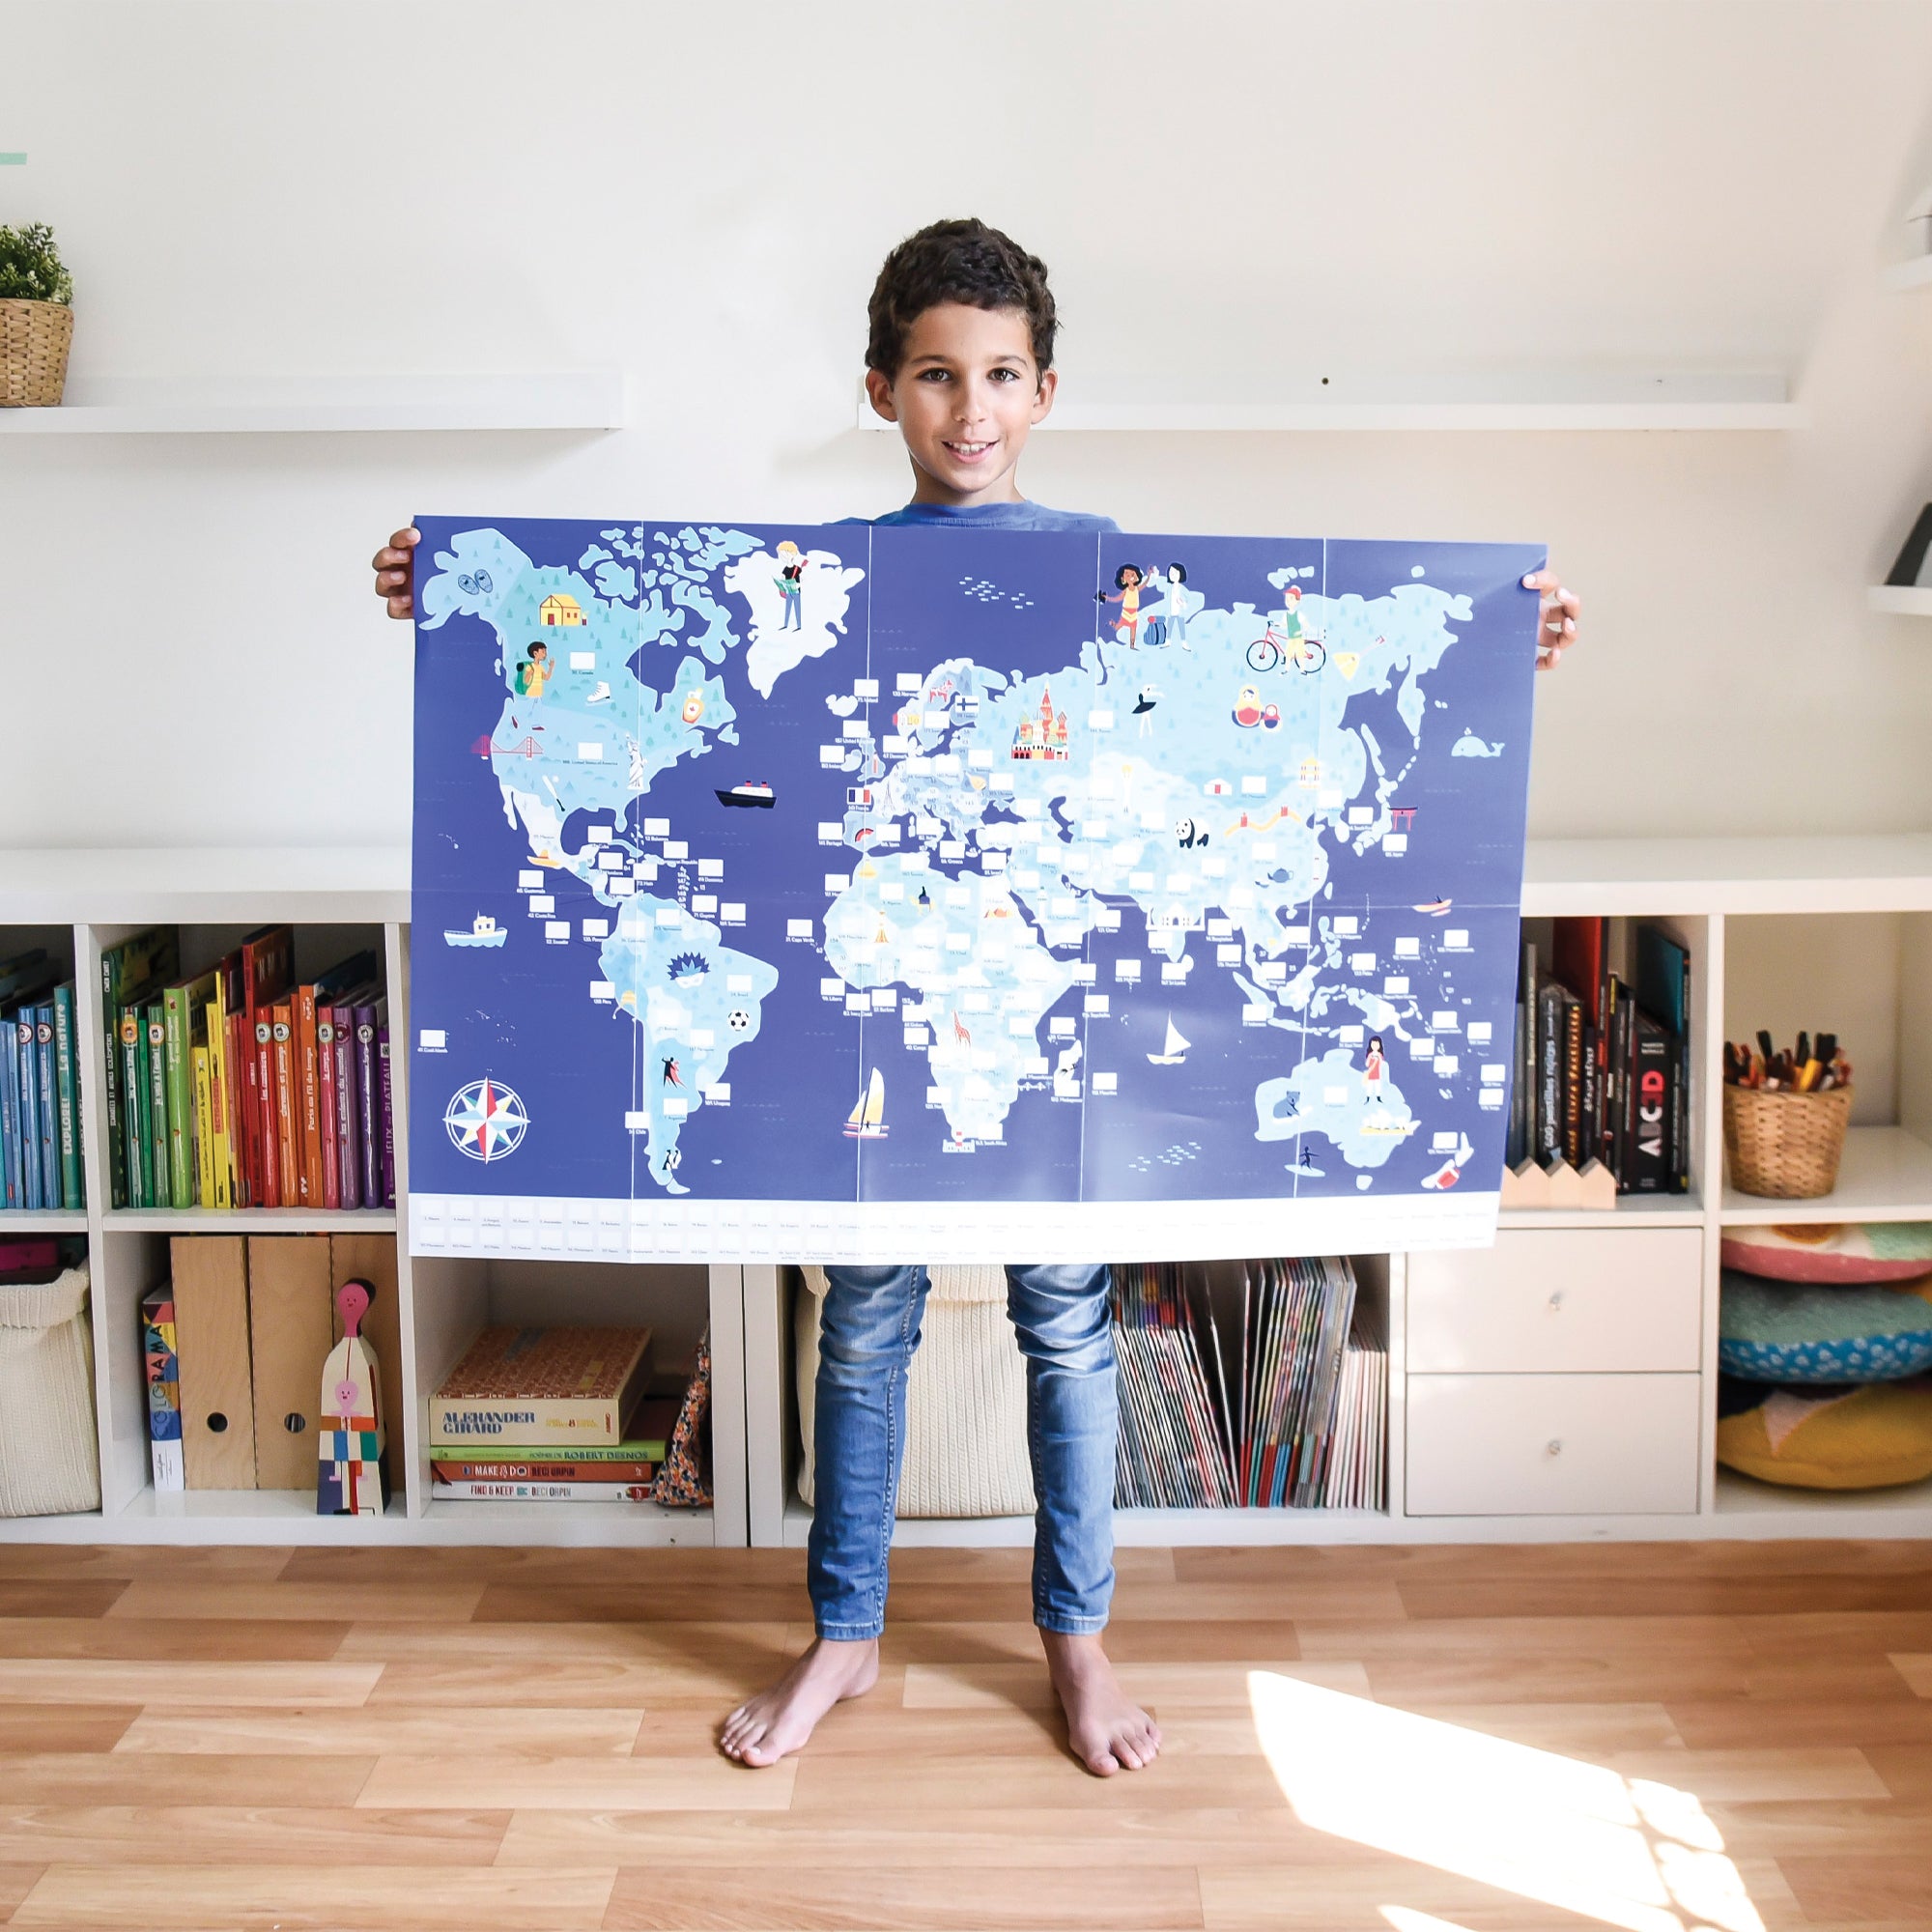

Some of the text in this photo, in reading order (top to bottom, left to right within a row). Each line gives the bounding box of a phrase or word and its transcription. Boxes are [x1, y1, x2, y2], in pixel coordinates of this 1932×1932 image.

[55, 1003, 66, 1051] nature
[56, 1055, 69, 1071] La
[336, 1048, 345, 1075] monde
[306, 1072, 313, 1084] du
[337, 1078, 345, 1089] du
[308, 1096, 314, 1108] au
[150, 1324, 168, 1436] COLORAMA
[443, 1412, 535, 1423] ALEXANDER
[443, 1422, 502, 1434] GIRARD
[474, 1465, 498, 1477] MAKE
[470, 1485, 488, 1496] FIND
[495, 1485, 514, 1496] KEEP
